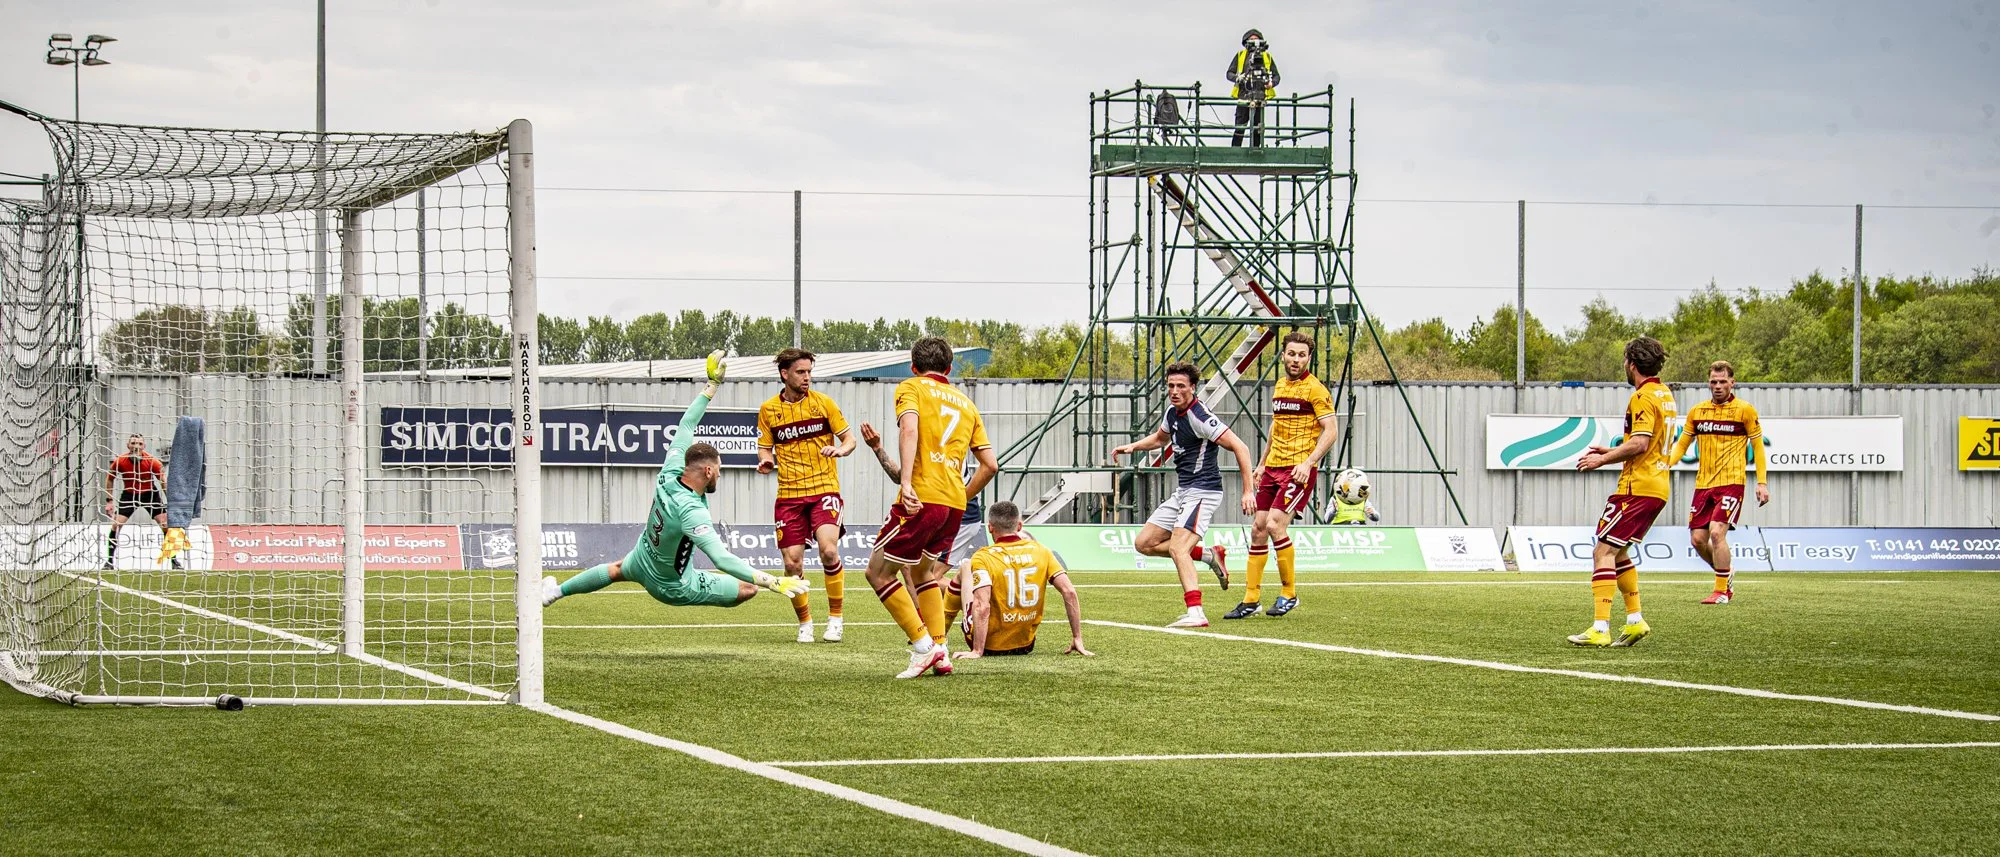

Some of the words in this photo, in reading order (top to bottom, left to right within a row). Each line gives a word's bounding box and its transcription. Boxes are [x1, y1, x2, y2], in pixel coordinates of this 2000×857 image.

[520, 341, 532, 431] MARKHARROD
[929, 388, 969, 409] SPARROW
[1281, 403, 1301, 411] CLAIMS
[785, 426, 799, 440] G4
[798, 423, 824, 435] CLAIMS
[940, 404, 961, 446] 7
[1703, 421, 1713, 433] G4
[391, 422, 457, 451] SIM
[470, 422, 679, 453] COTRACTS
[1770, 453, 1855, 465] CONTRACTS
[1861, 453, 1885, 465] LTD
[1285, 482, 1296, 499] 2
[821, 495, 840, 512] 20
[1721, 496, 1737, 511] 57
[227, 536, 261, 547] Your
[265, 536, 303, 547] Local
[395, 536, 446, 549] Experts
[1213, 529, 1325, 547] MAAY
[1332, 530, 1387, 546] MSP
[1866, 539, 1881, 551] T:
[1884, 539, 1924, 551] 0141
[1929, 539, 1960, 551] 442
[1528, 537, 1673, 566] indgo
[1687, 544, 1771, 561] ming
[1778, 544, 1800, 559] IT
[1805, 547, 1858, 561] easy
[758, 555, 782, 566] the
[1003, 566, 1040, 608] 16
